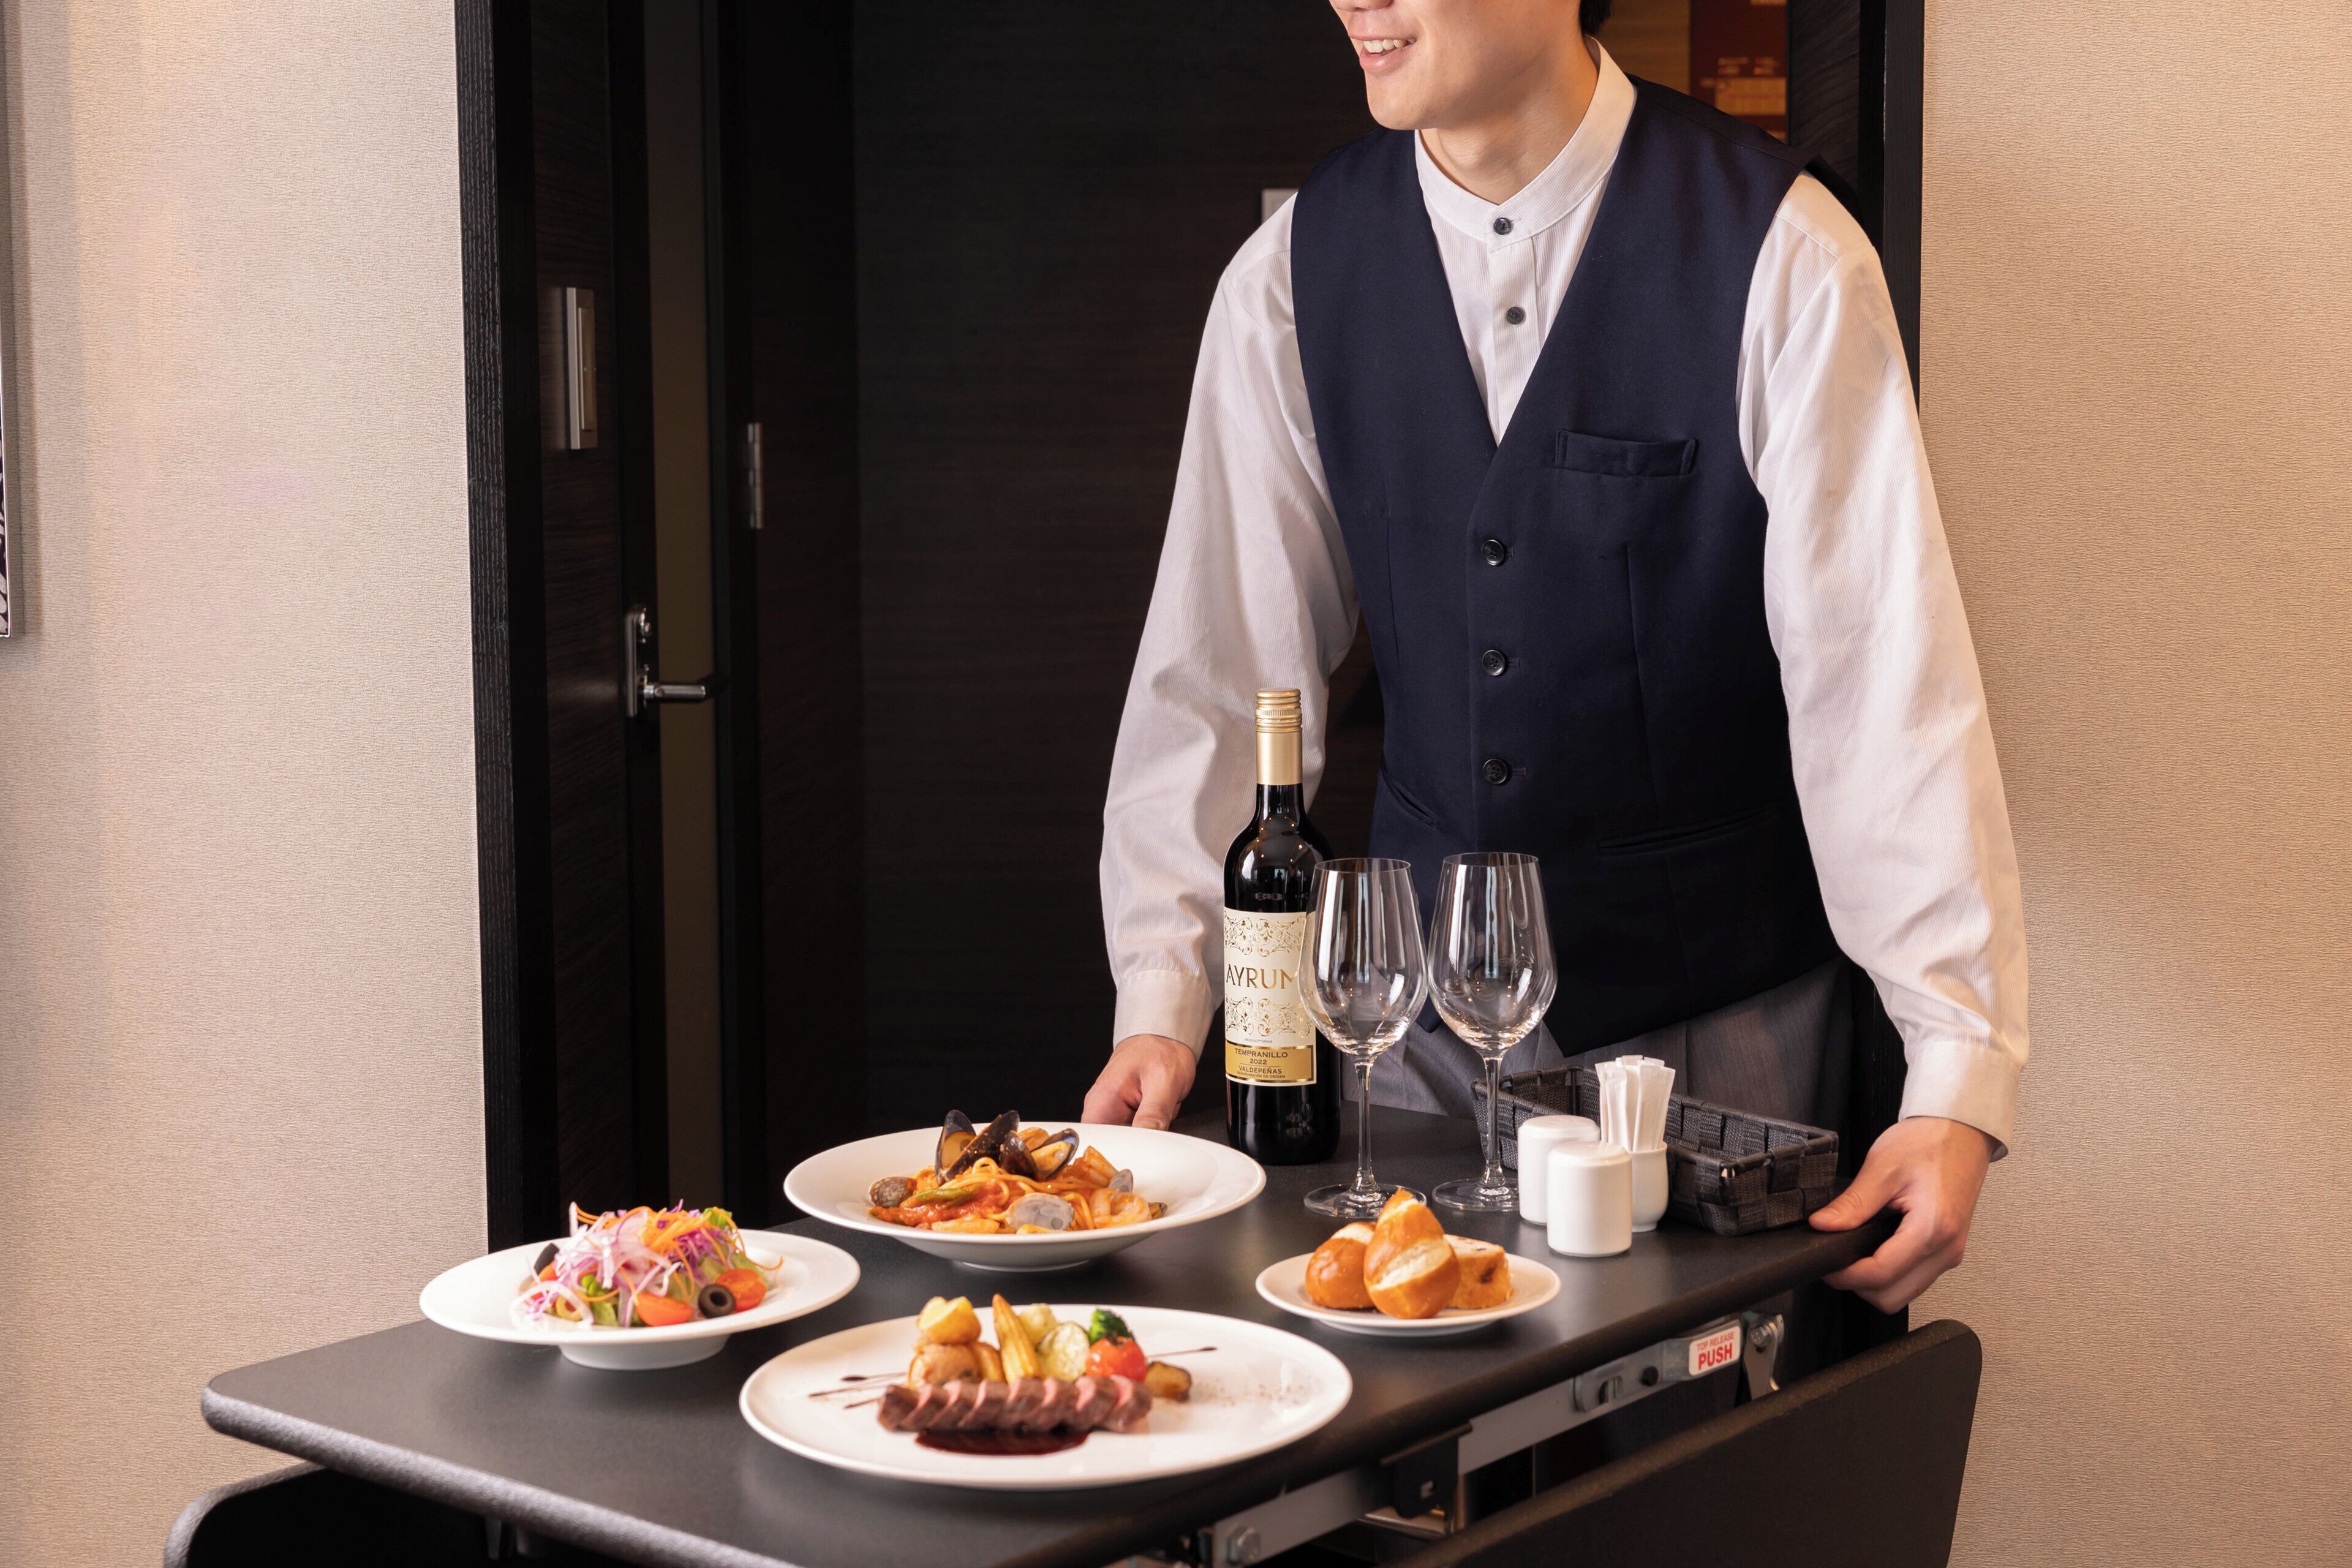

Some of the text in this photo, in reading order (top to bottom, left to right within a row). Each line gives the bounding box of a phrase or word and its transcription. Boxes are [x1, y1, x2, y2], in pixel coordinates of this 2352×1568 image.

[1226, 963, 1300, 989] AYRUM
[1235, 1048, 1288, 1058] TEMPRANILLO
[1238, 1066, 1282, 1074] VALDEPEÑAS
[1697, 1331, 1735, 1351] TOP RELEASE
[1698, 1343, 1733, 1371] PUSH
